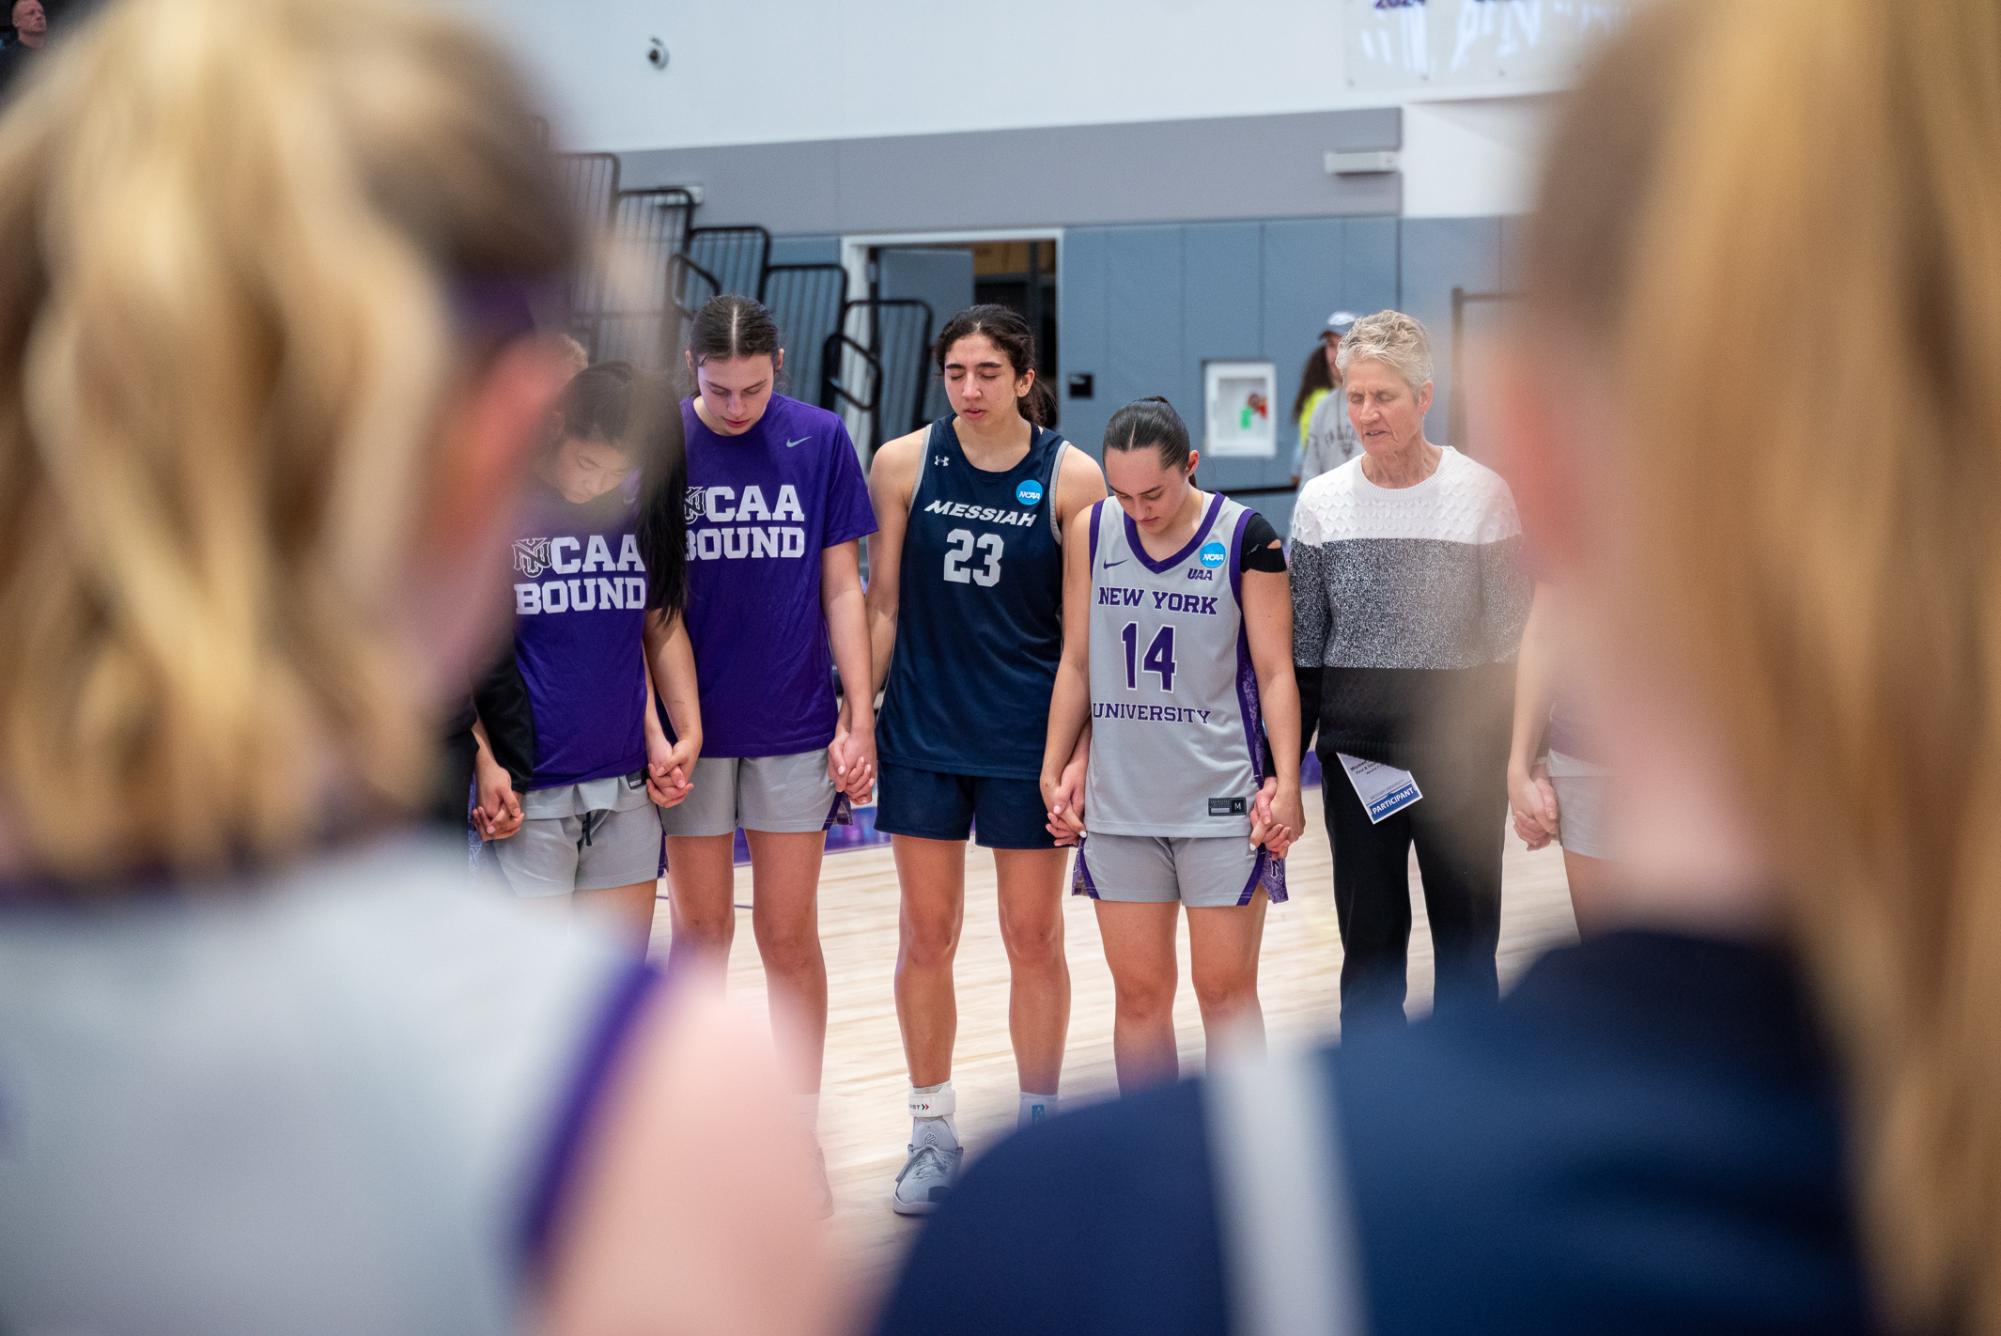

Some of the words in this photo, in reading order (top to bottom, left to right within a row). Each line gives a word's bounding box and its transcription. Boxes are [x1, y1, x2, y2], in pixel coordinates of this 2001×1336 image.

[1018, 490, 1042, 500] NCAA
[924, 500, 1037, 527] MESSIAH
[943, 528, 1005, 588] 23
[1202, 553, 1224, 562] NCAA
[1187, 568, 1213, 581] UAA
[513, 577, 647, 615] BOUND
[1098, 586, 1145, 607] NEW
[1151, 591, 1218, 615] YORK
[1121, 620, 1176, 694] 14
[1092, 702, 1212, 725] UNIVERSITY
[1234, 802, 1242, 811] M
[1371, 786, 1415, 815] PARTICIPANT
